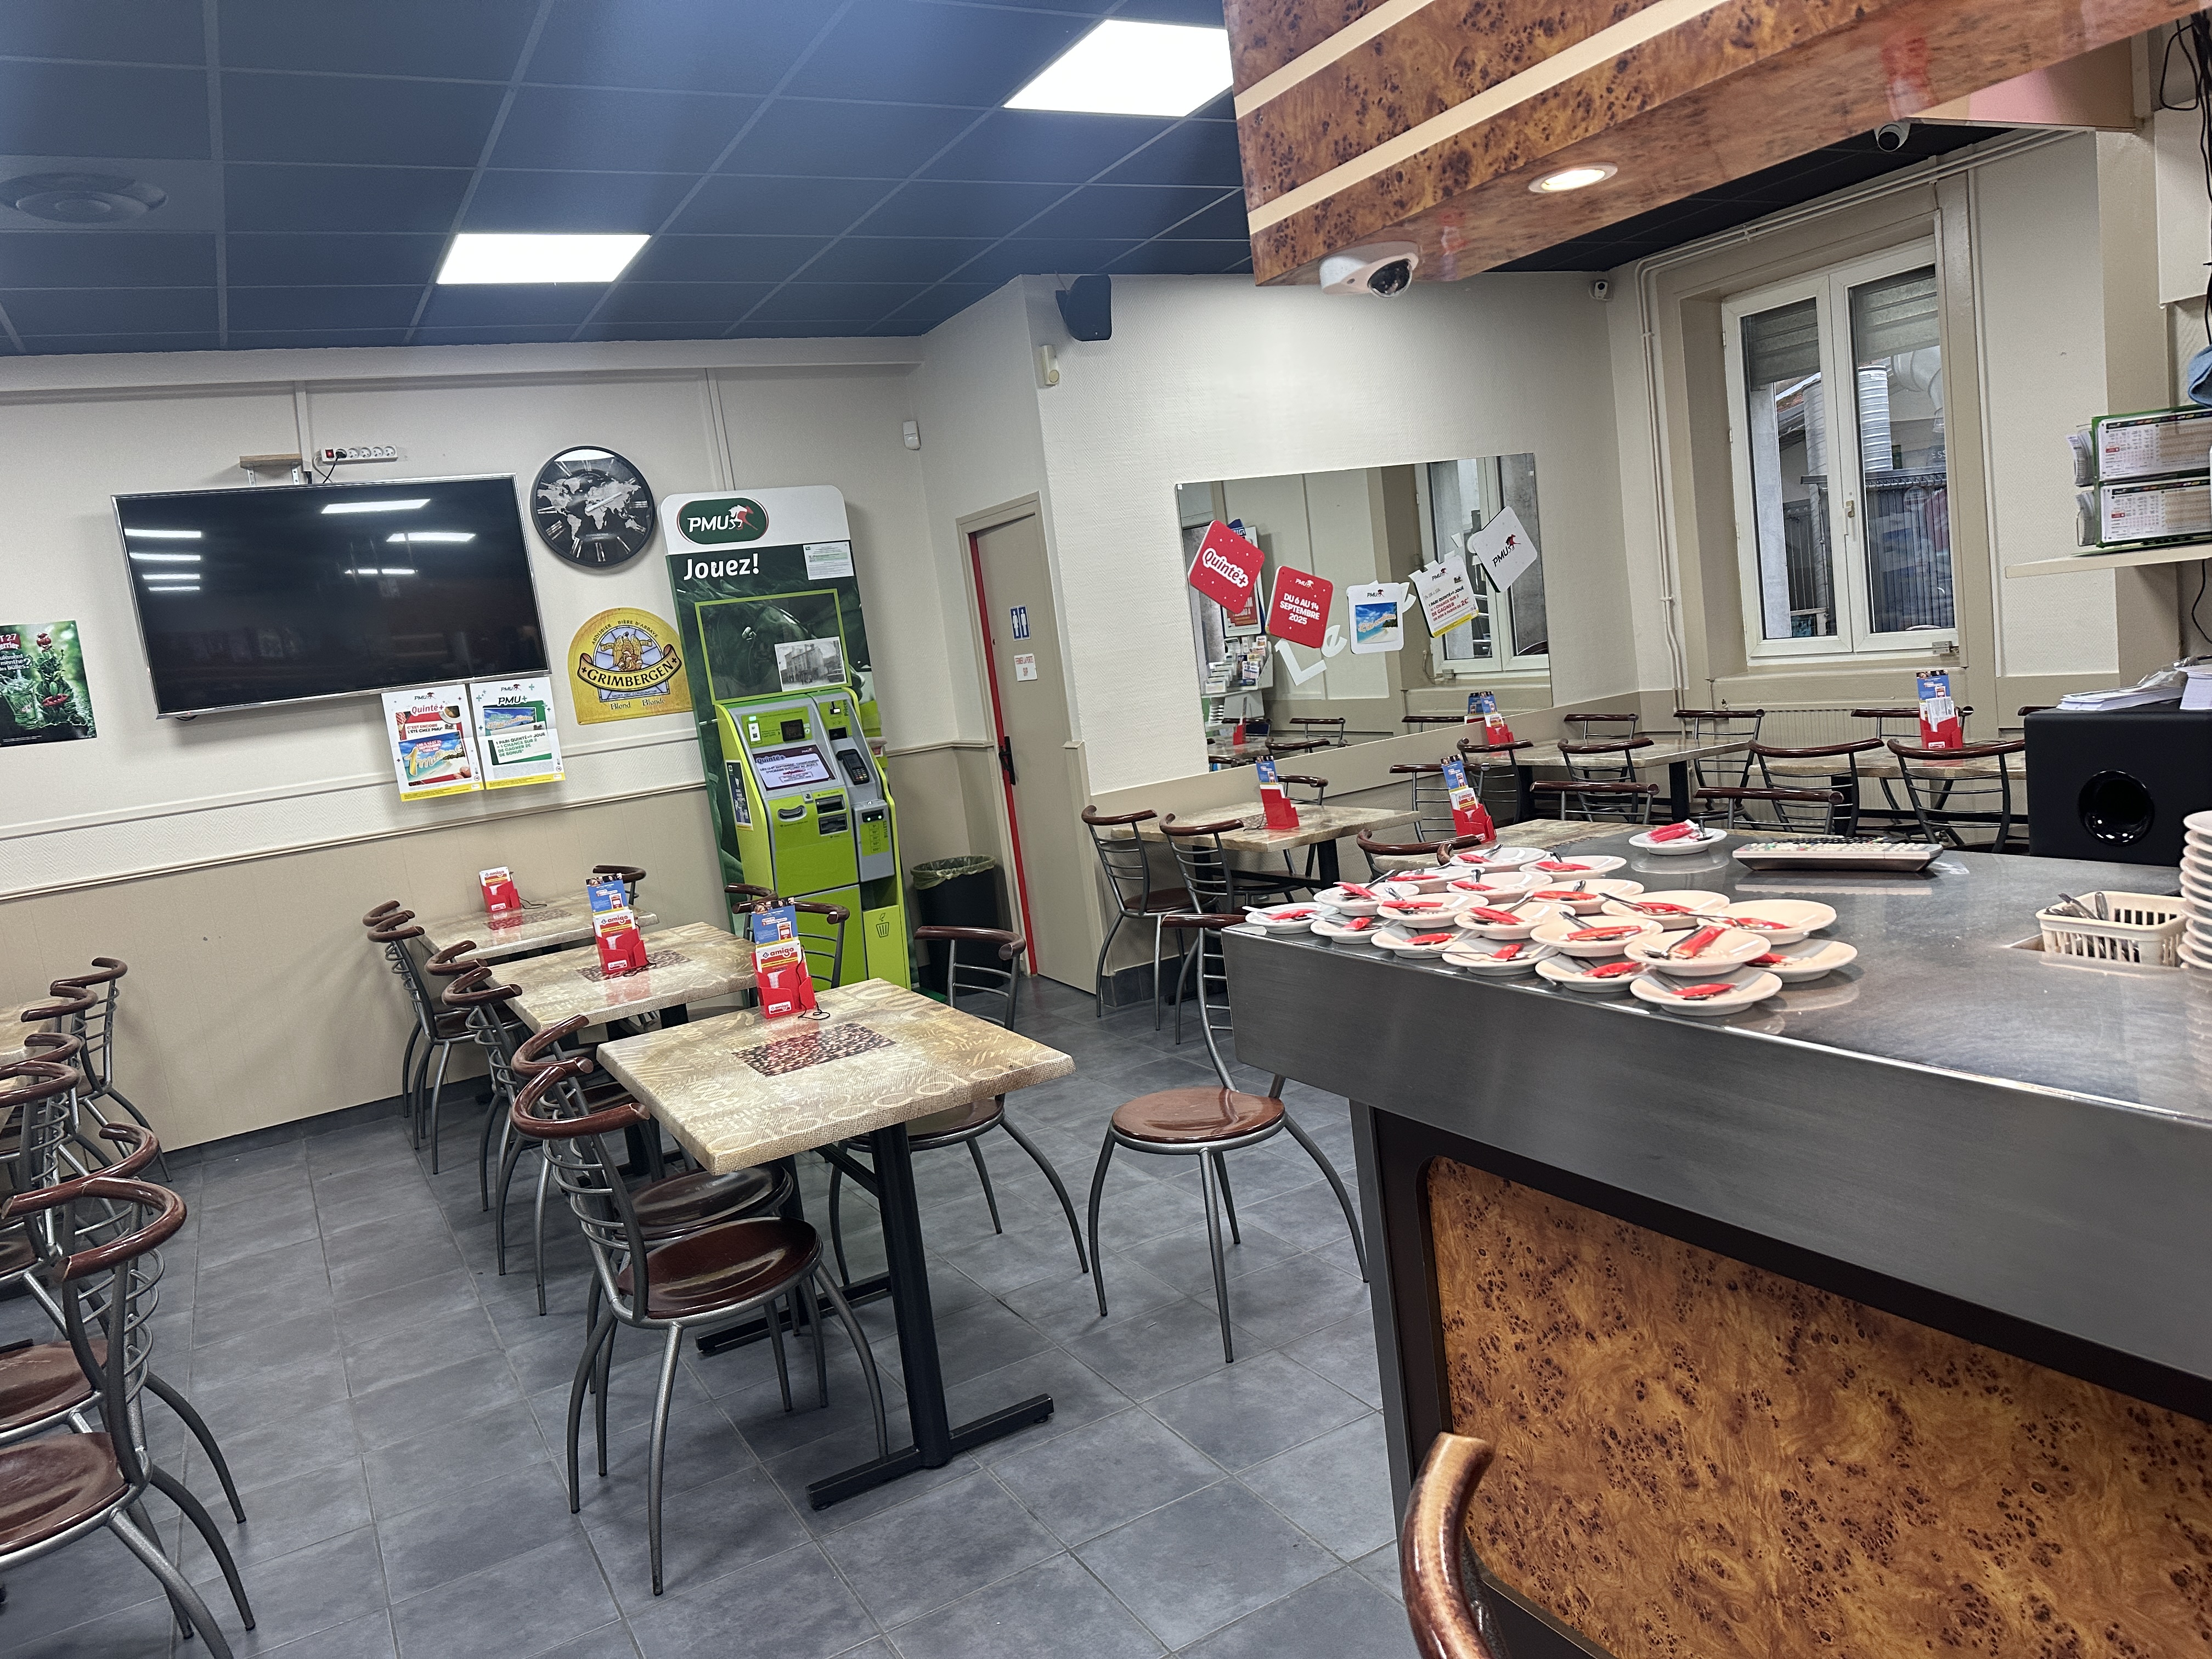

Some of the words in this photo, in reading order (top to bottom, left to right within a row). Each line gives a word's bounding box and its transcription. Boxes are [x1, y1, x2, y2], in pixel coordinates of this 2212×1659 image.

[687, 515, 730, 532] PMU
[1492, 546, 1509, 567] PMU
[684, 553, 760, 580] Jouez!
[1204, 550, 1246, 584] Quinté+
[1295, 578, 1307, 586] PMU
[1432, 572, 1442, 582] PMU
[1283, 592, 1294, 603] DU
[1294, 596, 1299, 604] 6
[1300, 598, 1310, 607] AU
[1311, 602, 1319, 611] 14
[1437, 602, 1454, 613] GAGNER
[1280, 601, 1320, 620] SEPTEMBRE
[1288, 613, 1308, 625] 2025
[635, 621, 658, 638] D'ABBAYE
[5, 633, 17, 641] 27
[587, 662, 674, 687] GRIMBERGEN
[498, 695, 527, 705] PMU+
[611, 702, 631, 710] Blond
[642, 697, 665, 707] Blonde
[411, 703, 444, 715] Quinté+
[757, 755, 785, 764] Quinté+
[608, 915, 628, 924] amigo
[770, 947, 794, 957] amigo
